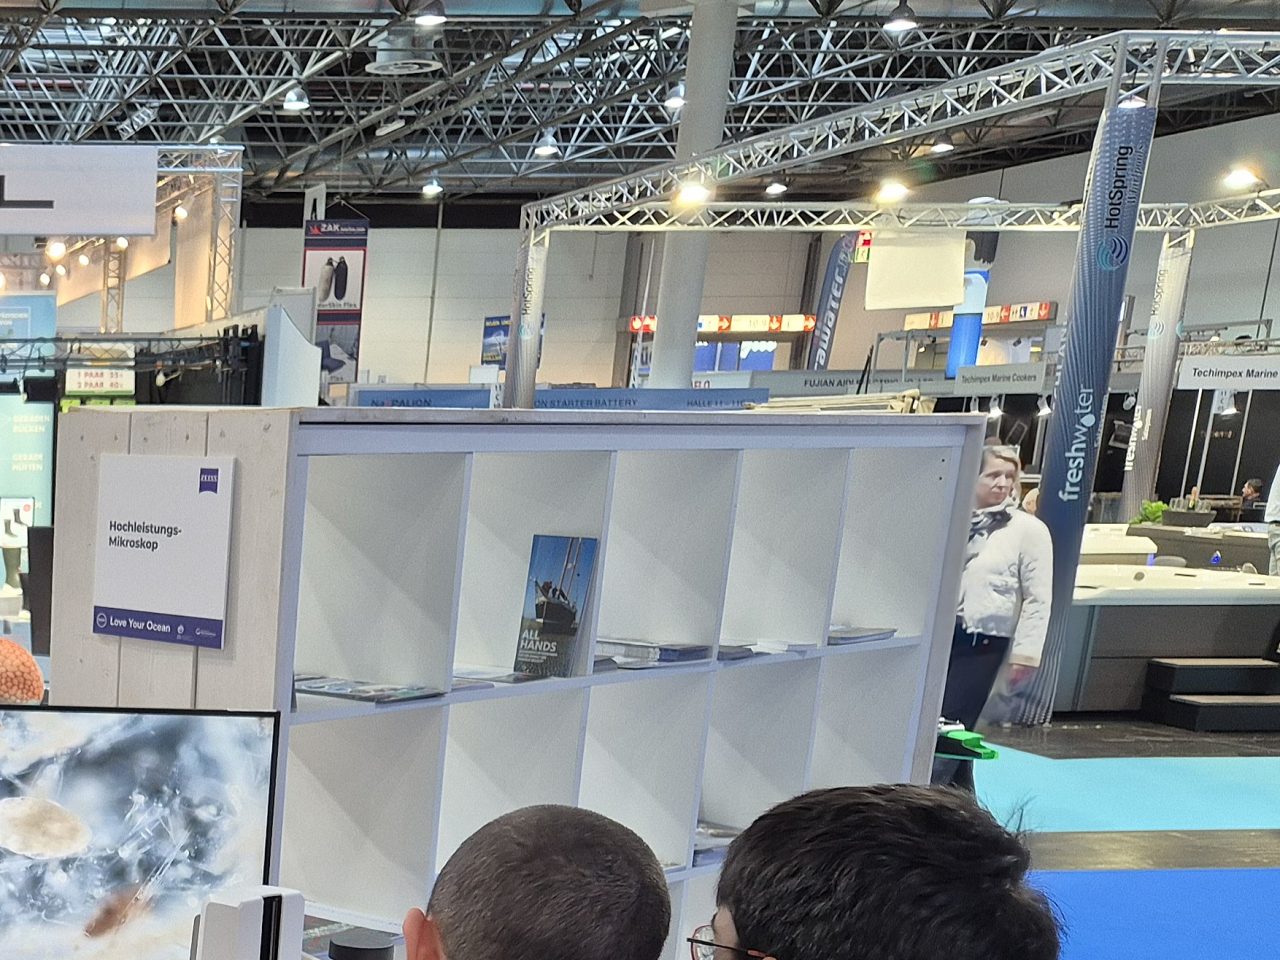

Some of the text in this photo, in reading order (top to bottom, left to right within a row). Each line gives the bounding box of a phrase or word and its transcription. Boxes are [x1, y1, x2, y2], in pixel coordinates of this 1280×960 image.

[1105, 145, 1133, 229] HotSpring
[1193, 367, 1279, 379] Techimpex Marine
[109, 520, 182, 538] Hochleistungs-
[109, 536, 158, 552] Mikroskop
[110, 615, 127, 628] Love
[128, 617, 145, 630] Your
[146, 620, 171, 633] Ocean
[522, 629, 540, 640] ALL
[520, 640, 557, 652] HANDS
